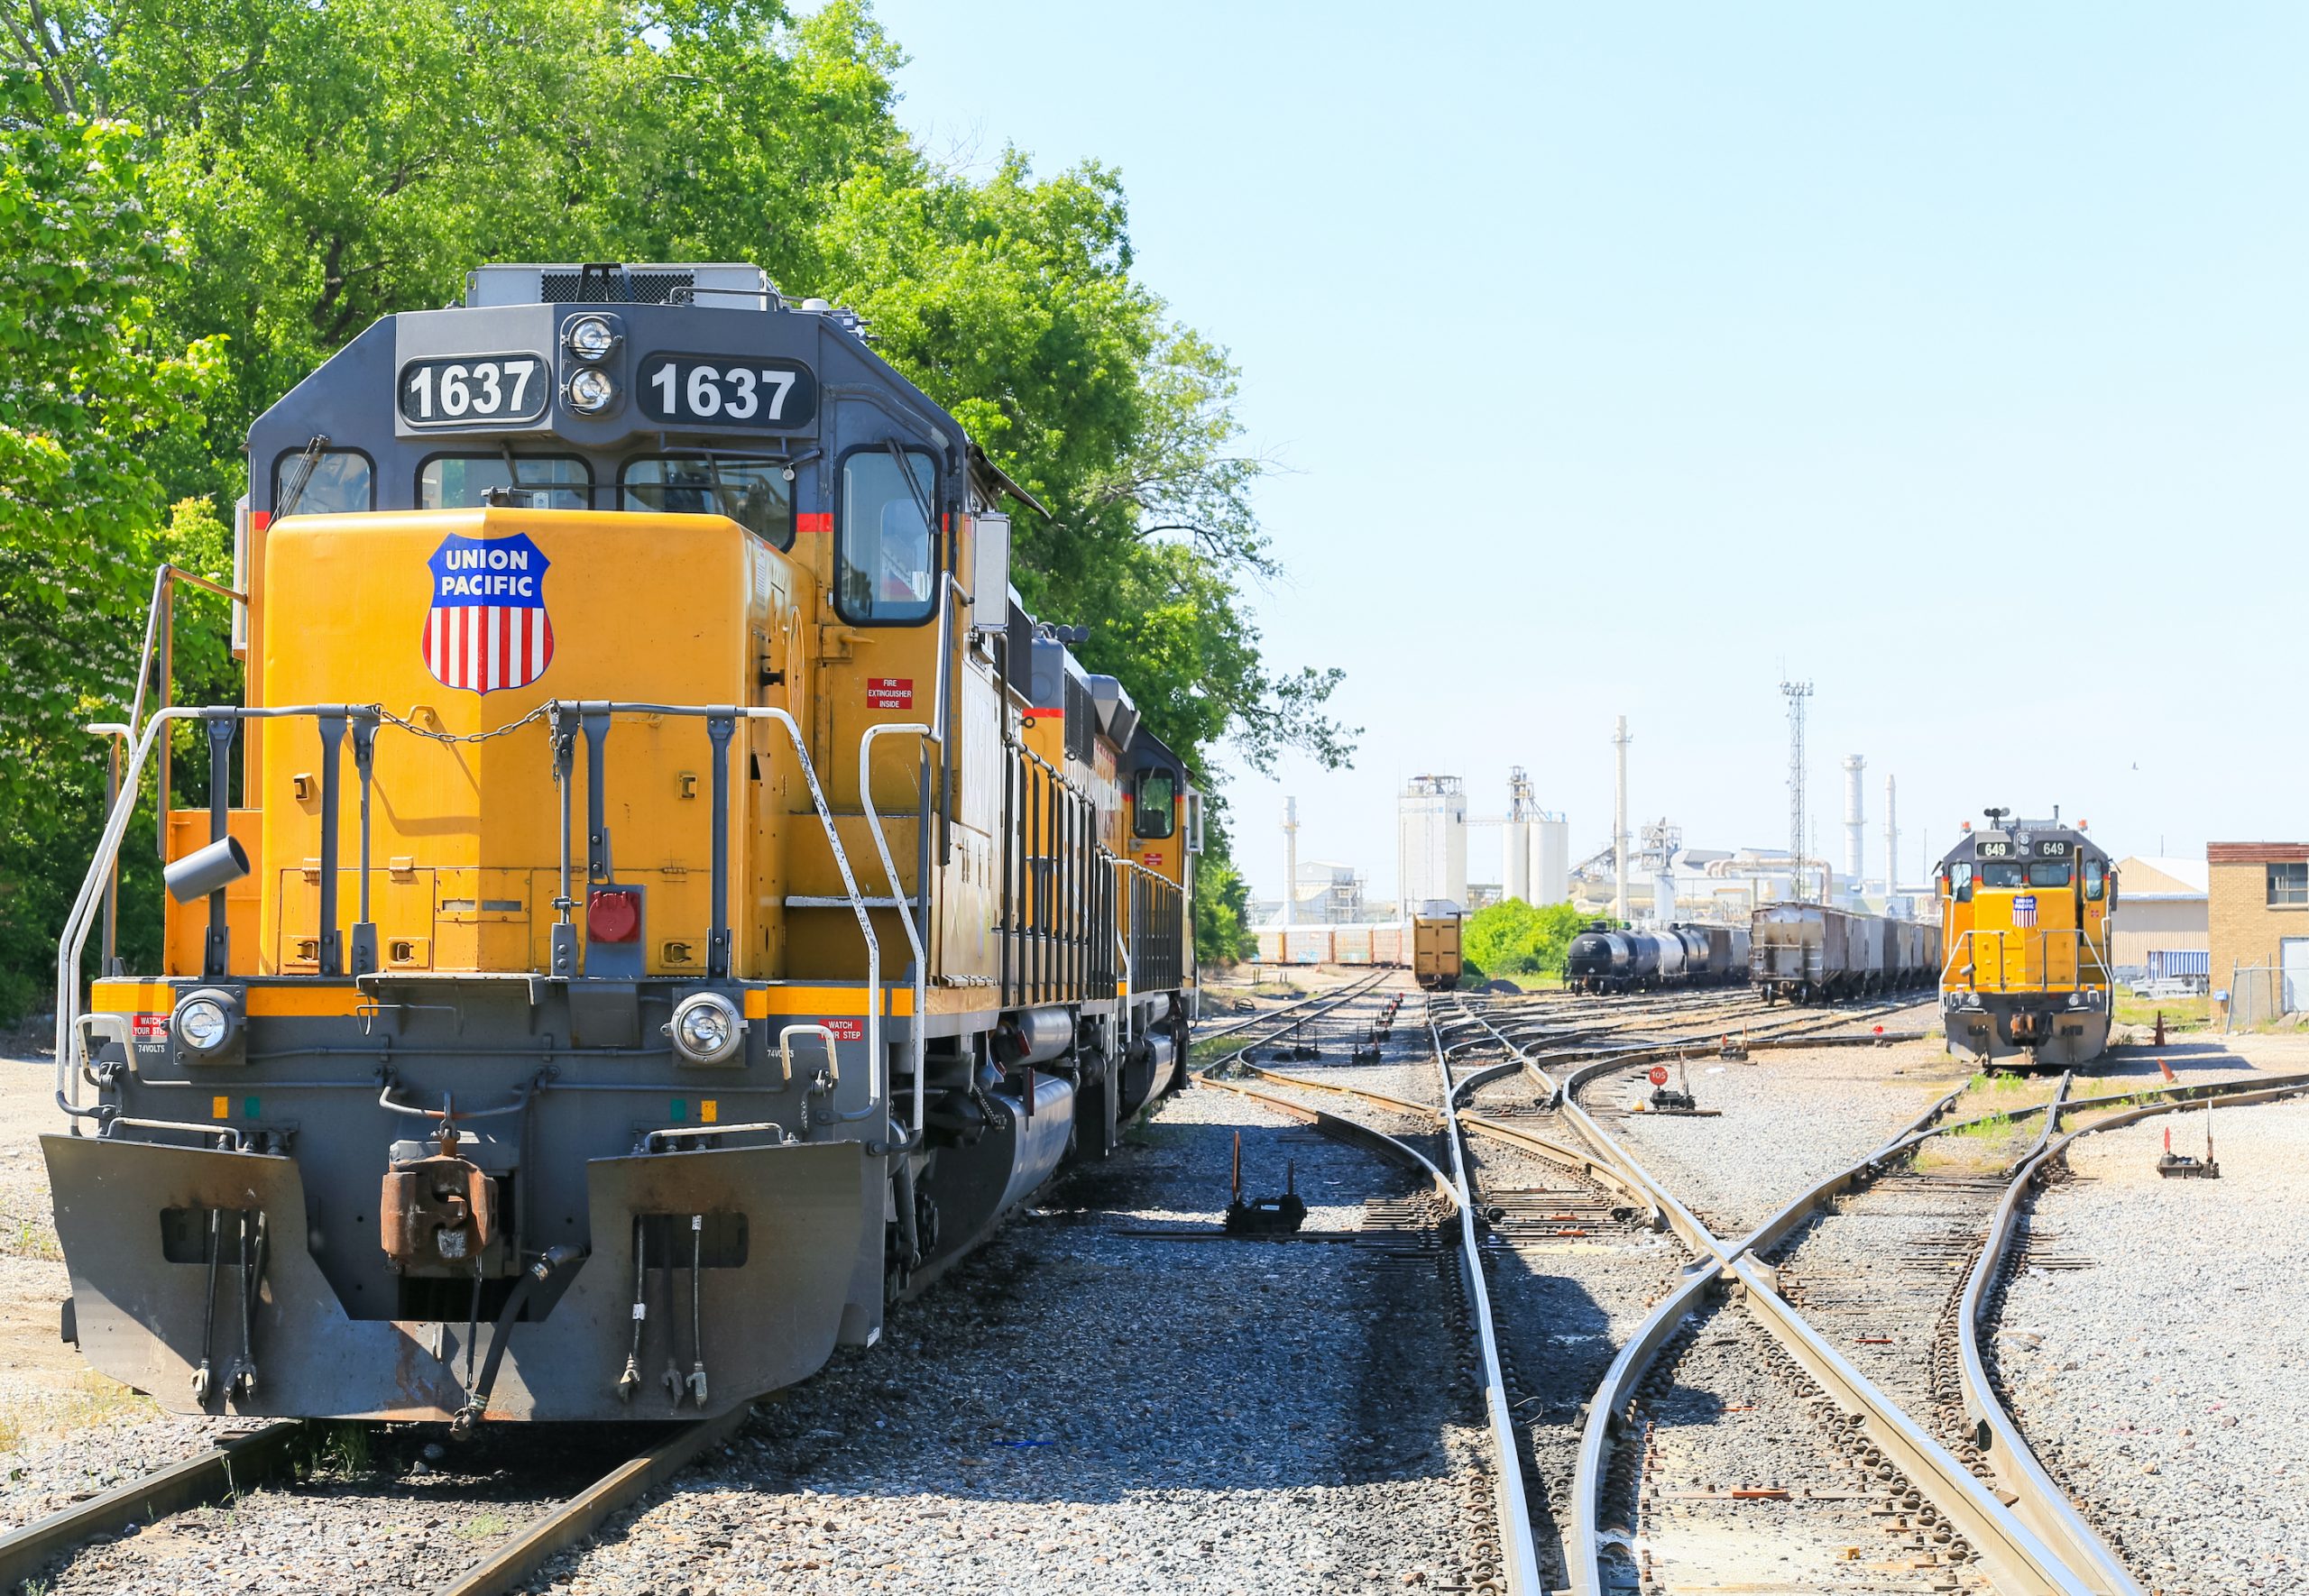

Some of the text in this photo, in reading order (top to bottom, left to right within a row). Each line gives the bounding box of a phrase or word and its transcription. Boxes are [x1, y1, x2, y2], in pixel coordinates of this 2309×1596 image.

[410, 361, 534, 417] 1637
[651, 363, 796, 420] 1637
[446, 548, 528, 570] UNION
[441, 574, 533, 597] PACIFIC
[883, 679, 897, 687] FIRE
[868, 689, 912, 698] EXTINGUISHER
[879, 700, 900, 708] INSIDE
[1984, 843, 2007, 857] 649
[2043, 842, 2065, 856] 649
[140, 1017, 161, 1025] WATCH
[828, 1021, 853, 1029] WATCH
[133, 1026, 151, 1035] YOUR
[842, 1032, 861, 1040] STEP
[138, 1044, 165, 1053] 74VOLTS
